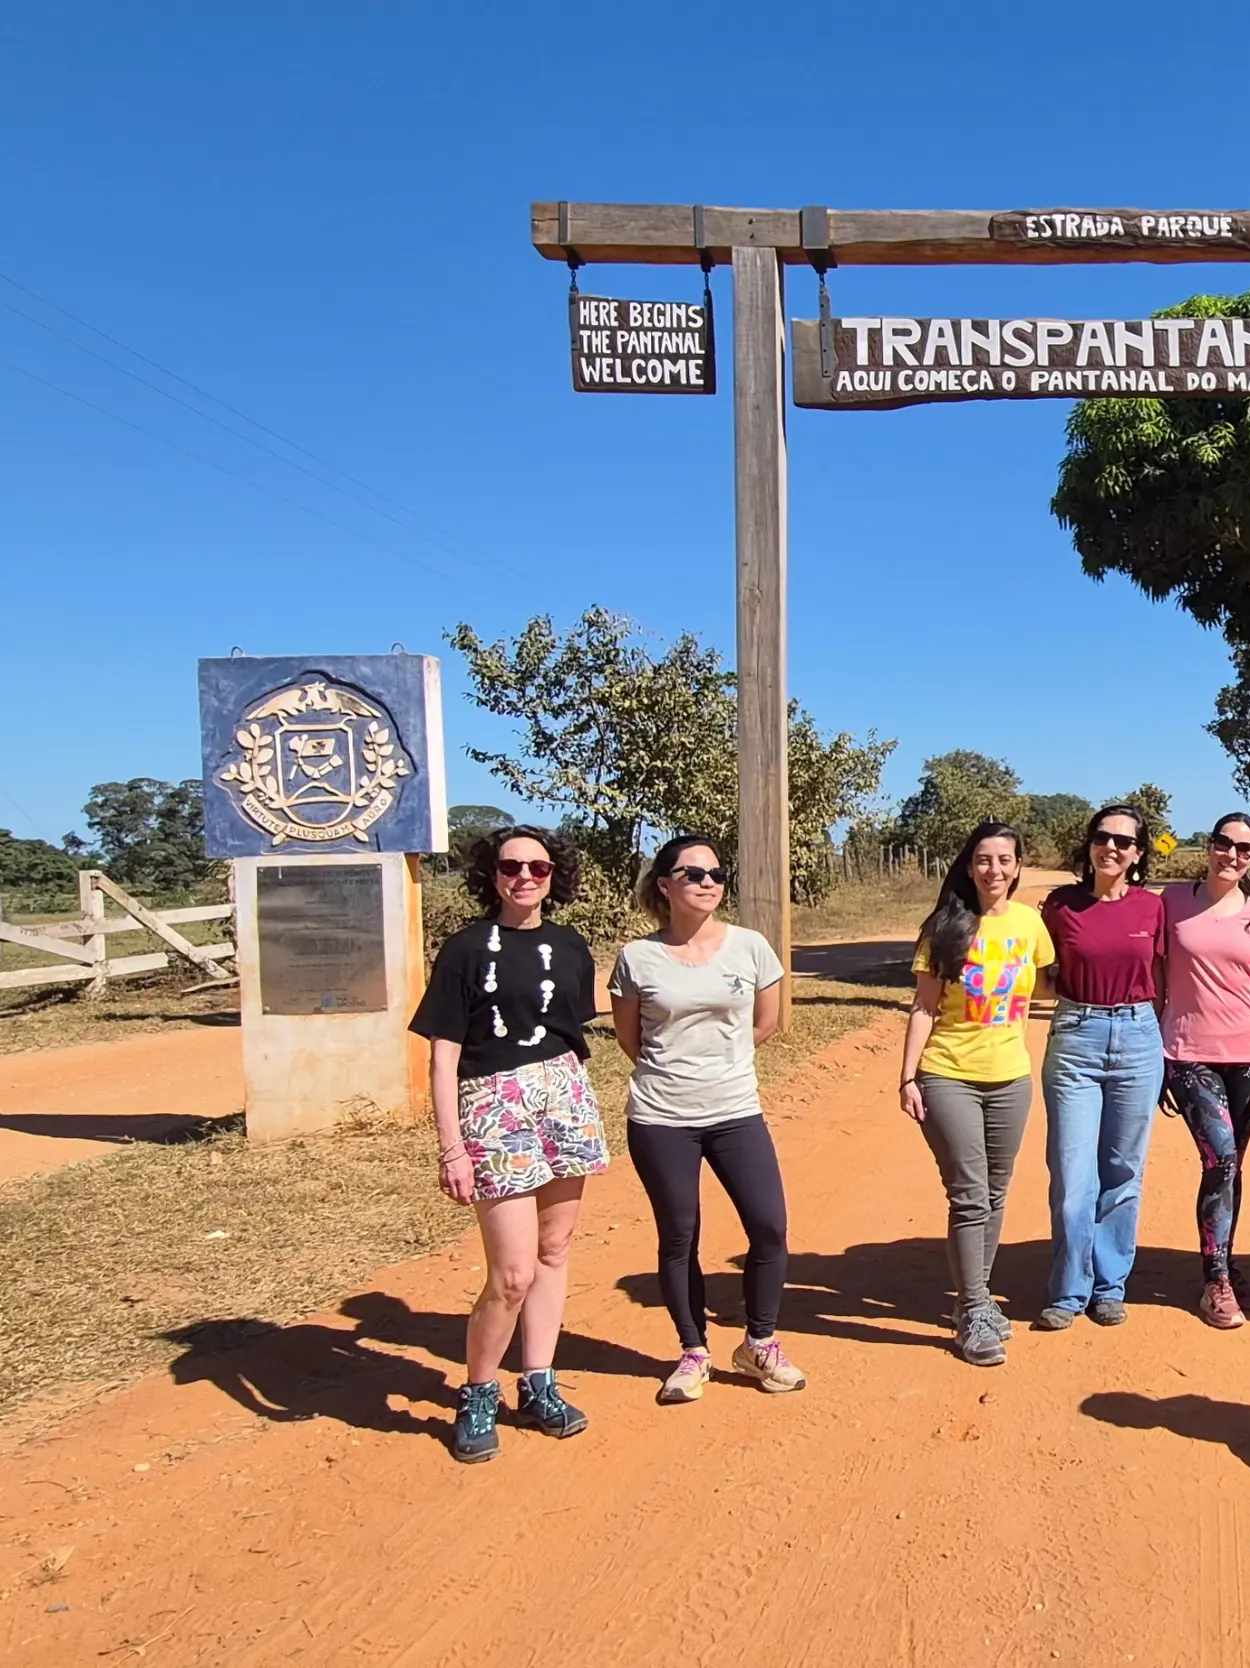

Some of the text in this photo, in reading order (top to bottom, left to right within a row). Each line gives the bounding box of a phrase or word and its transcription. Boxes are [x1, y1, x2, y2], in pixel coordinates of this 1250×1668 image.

[1026, 213, 1232, 238] ESTRADA PARQUE
[579, 301, 703, 327] HERE BEGINS
[580, 330, 705, 354] THE PANTANAL
[581, 357, 704, 384] WELCOME
[836, 370, 891, 391] AQUI
[898, 370, 994, 392] COMEÇA
[1003, 370, 1015, 390] O
[1031, 370, 1174, 391] PANTANAL
[1187, 372, 1216, 391] DO
[245, 798, 280, 831] VIRTUTE
[362, 798, 387, 826] AURO
